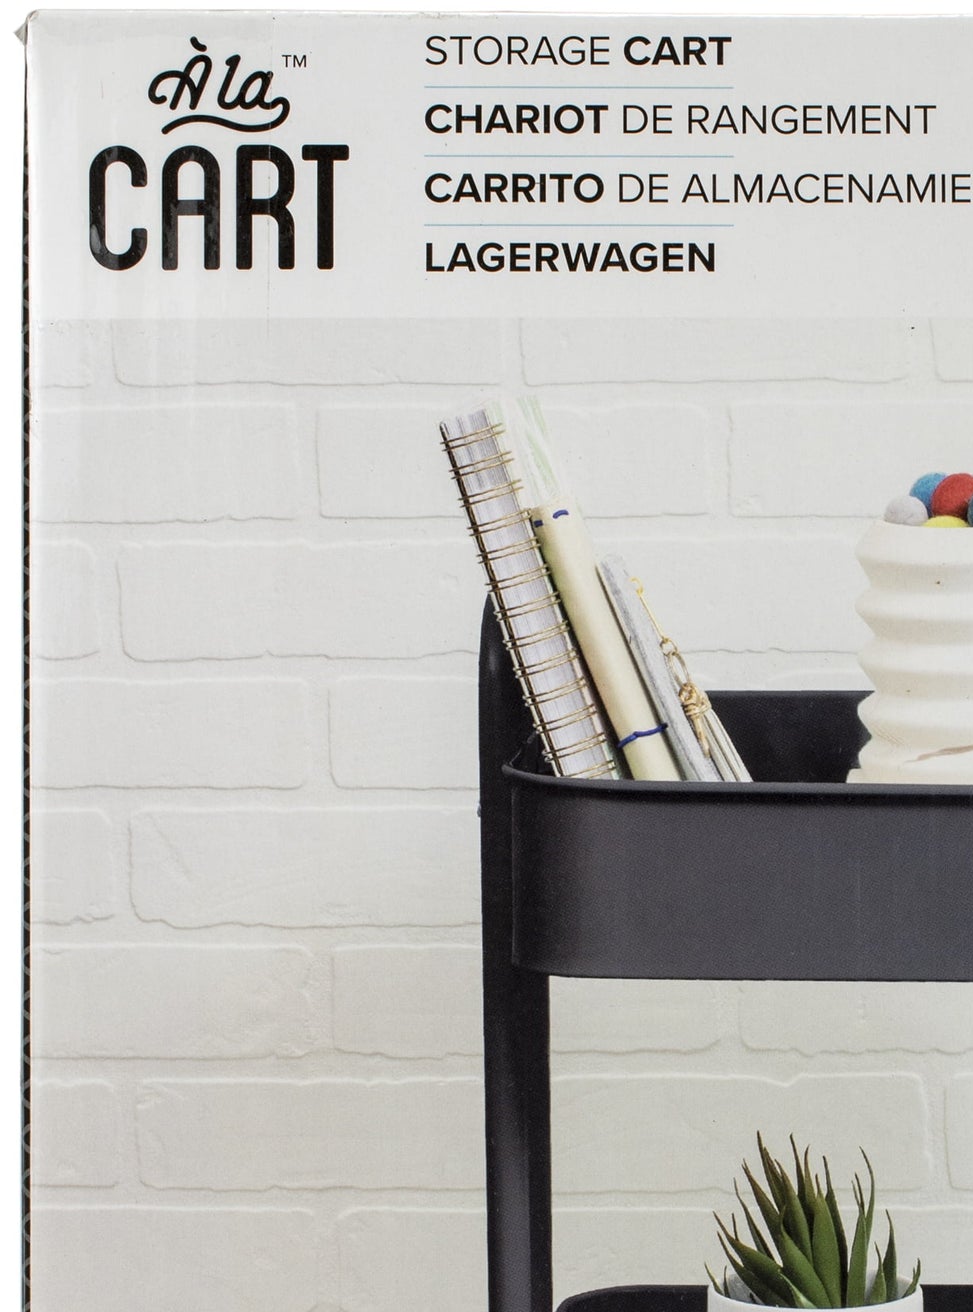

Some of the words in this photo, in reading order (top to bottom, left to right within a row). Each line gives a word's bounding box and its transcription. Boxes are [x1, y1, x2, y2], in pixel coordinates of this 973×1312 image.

[425, 35, 611, 66] STORAGE
[623, 35, 733, 66] CART
[424, 103, 609, 135] CHARIOT
[622, 104, 673, 135] DE
[687, 104, 937, 135] RANGEMENT
[424, 172, 605, 204] CARRITO
[618, 173, 669, 204] DE
[88, 143, 350, 272] CART
[425, 241, 716, 273] LAGERWAGEN
